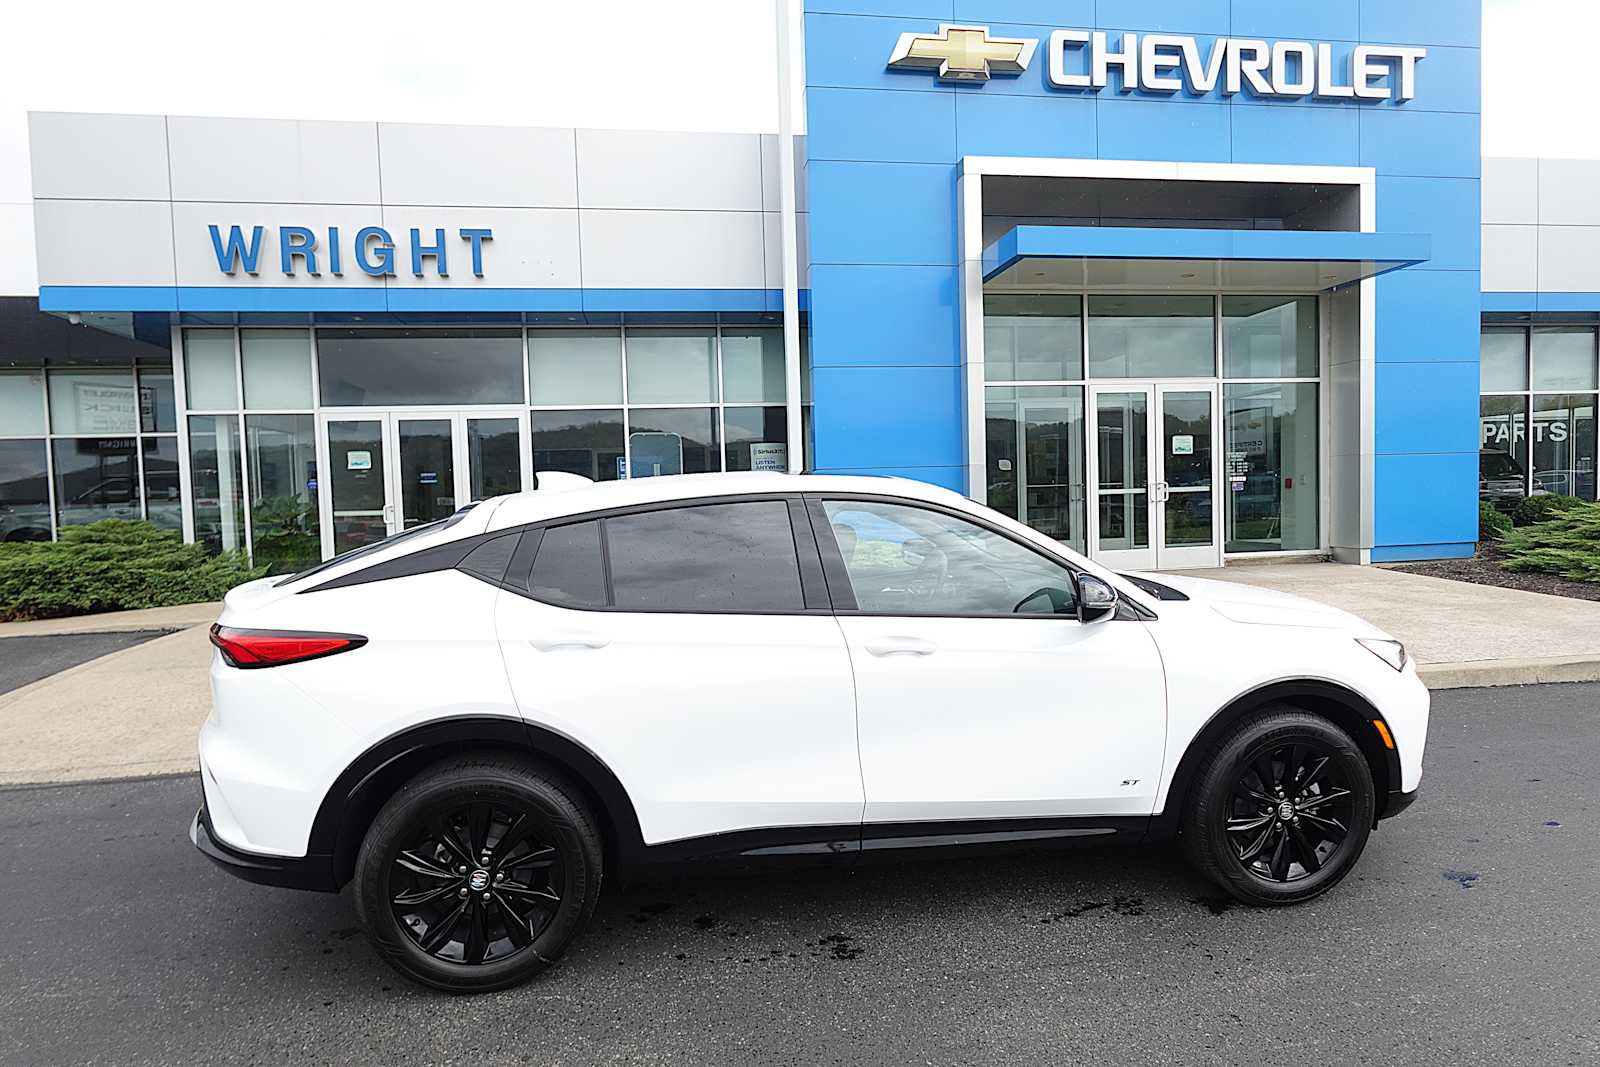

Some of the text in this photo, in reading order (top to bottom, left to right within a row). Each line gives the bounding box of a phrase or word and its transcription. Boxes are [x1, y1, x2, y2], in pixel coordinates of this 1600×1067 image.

[1048, 29, 1427, 103] CHEVROLET
[207, 224, 494, 278] WRIGHT
[1483, 422, 1567, 443] PARTS
